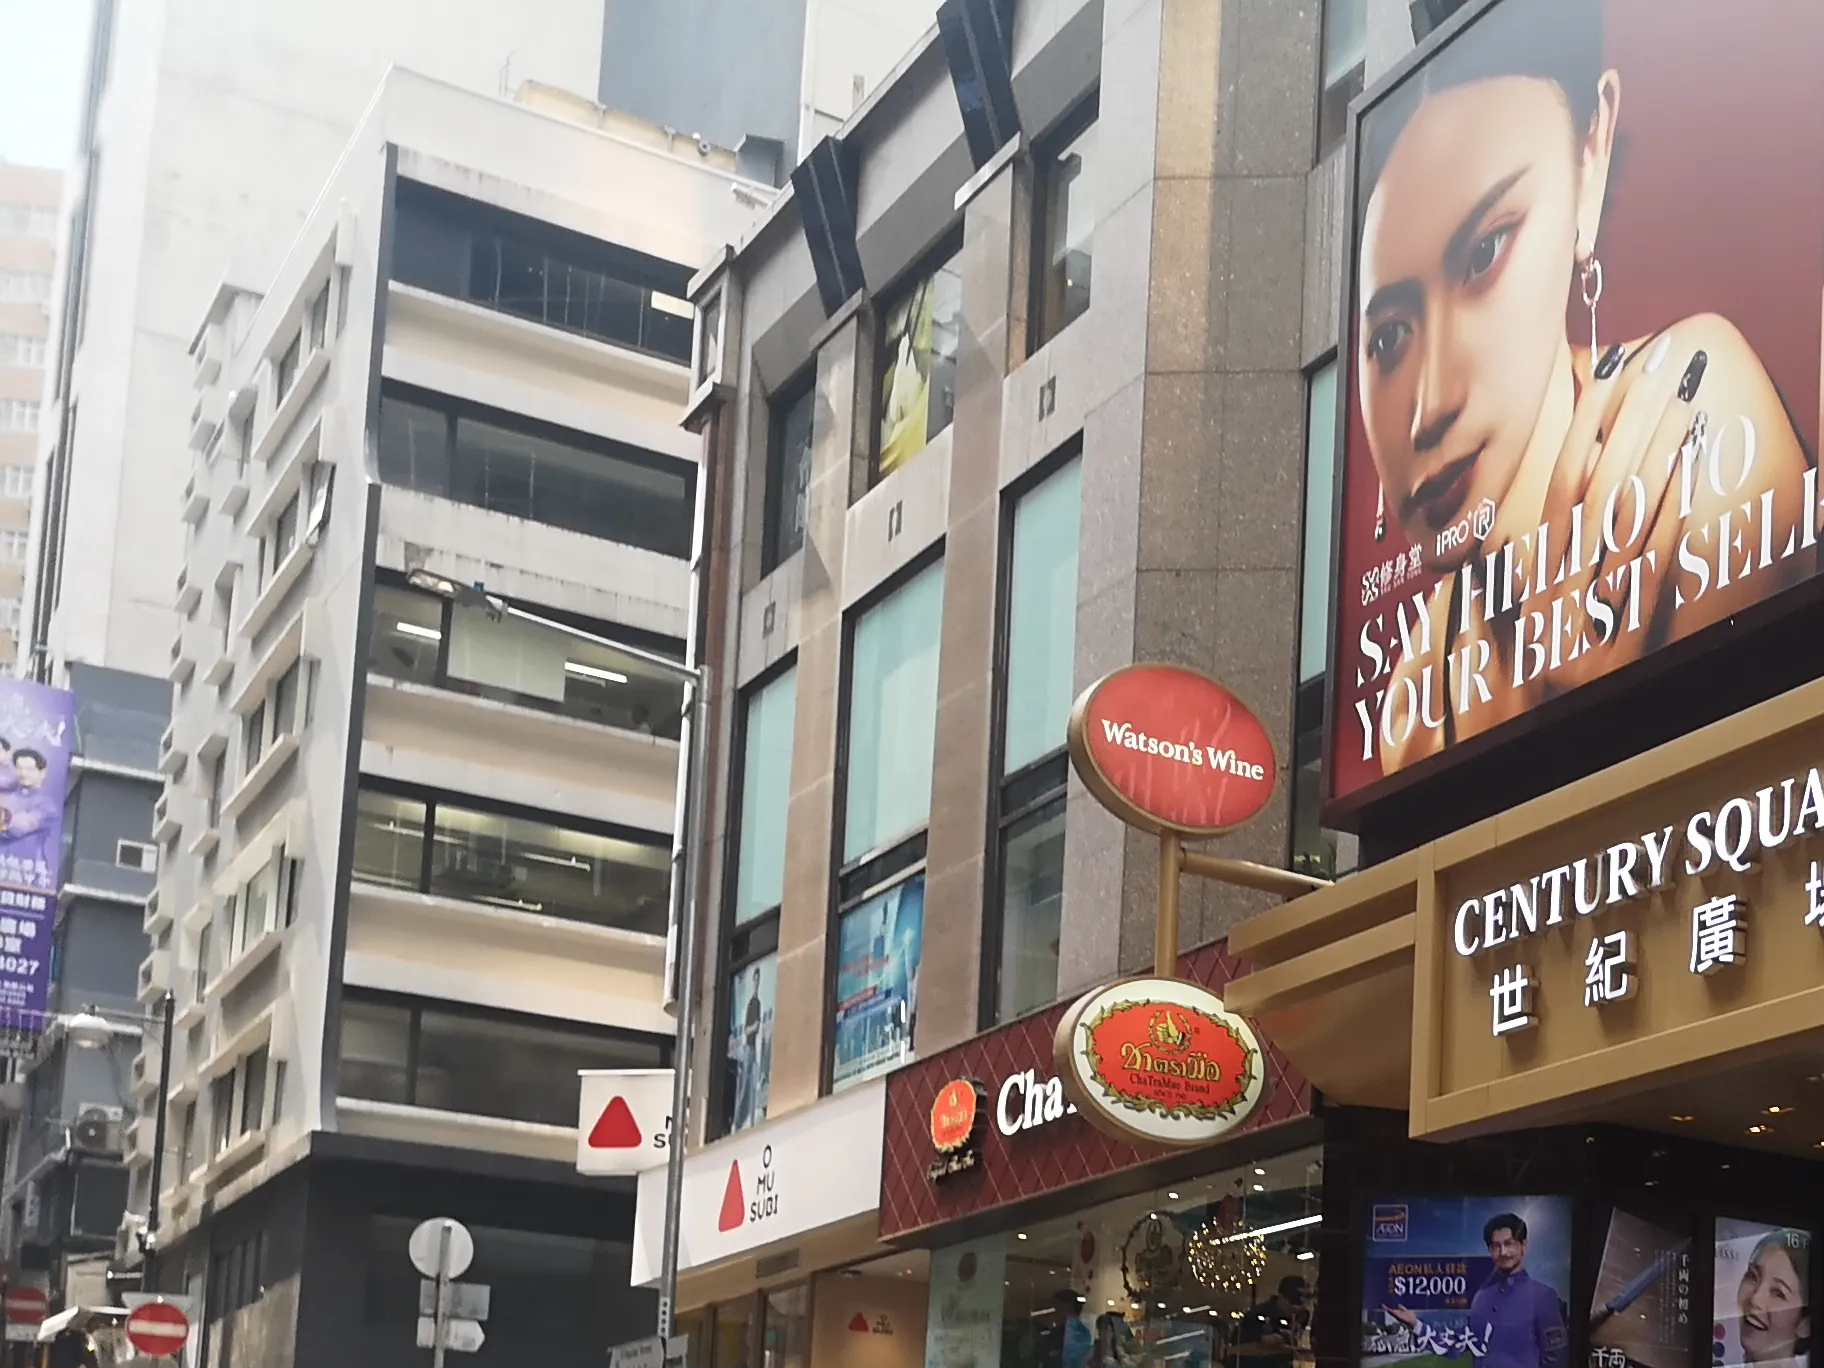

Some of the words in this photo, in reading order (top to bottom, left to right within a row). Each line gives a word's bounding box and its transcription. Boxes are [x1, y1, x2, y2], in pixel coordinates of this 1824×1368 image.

[1357, 581, 1444, 688] SAY
[1459, 474, 1646, 635] HELLO
[1668, 415, 1756, 519] TO
[1381, 543, 1422, 585] 修身堂
[1355, 638, 1494, 761] YOUR
[1512, 550, 1657, 689] BEST
[1101, 718, 1203, 765] Watson's
[1206, 746, 1264, 780] Wine
[1454, 825, 1674, 957] CENTURY
[997, 1068, 1078, 1136] Cha
[1184, 1081, 1210, 1095] Brand
[762, 1145, 773, 1168] O
[756, 1171, 775, 1195] MU
[749, 1194, 779, 1222] SUBI
[1394, 1276, 1466, 1296] $12,000
